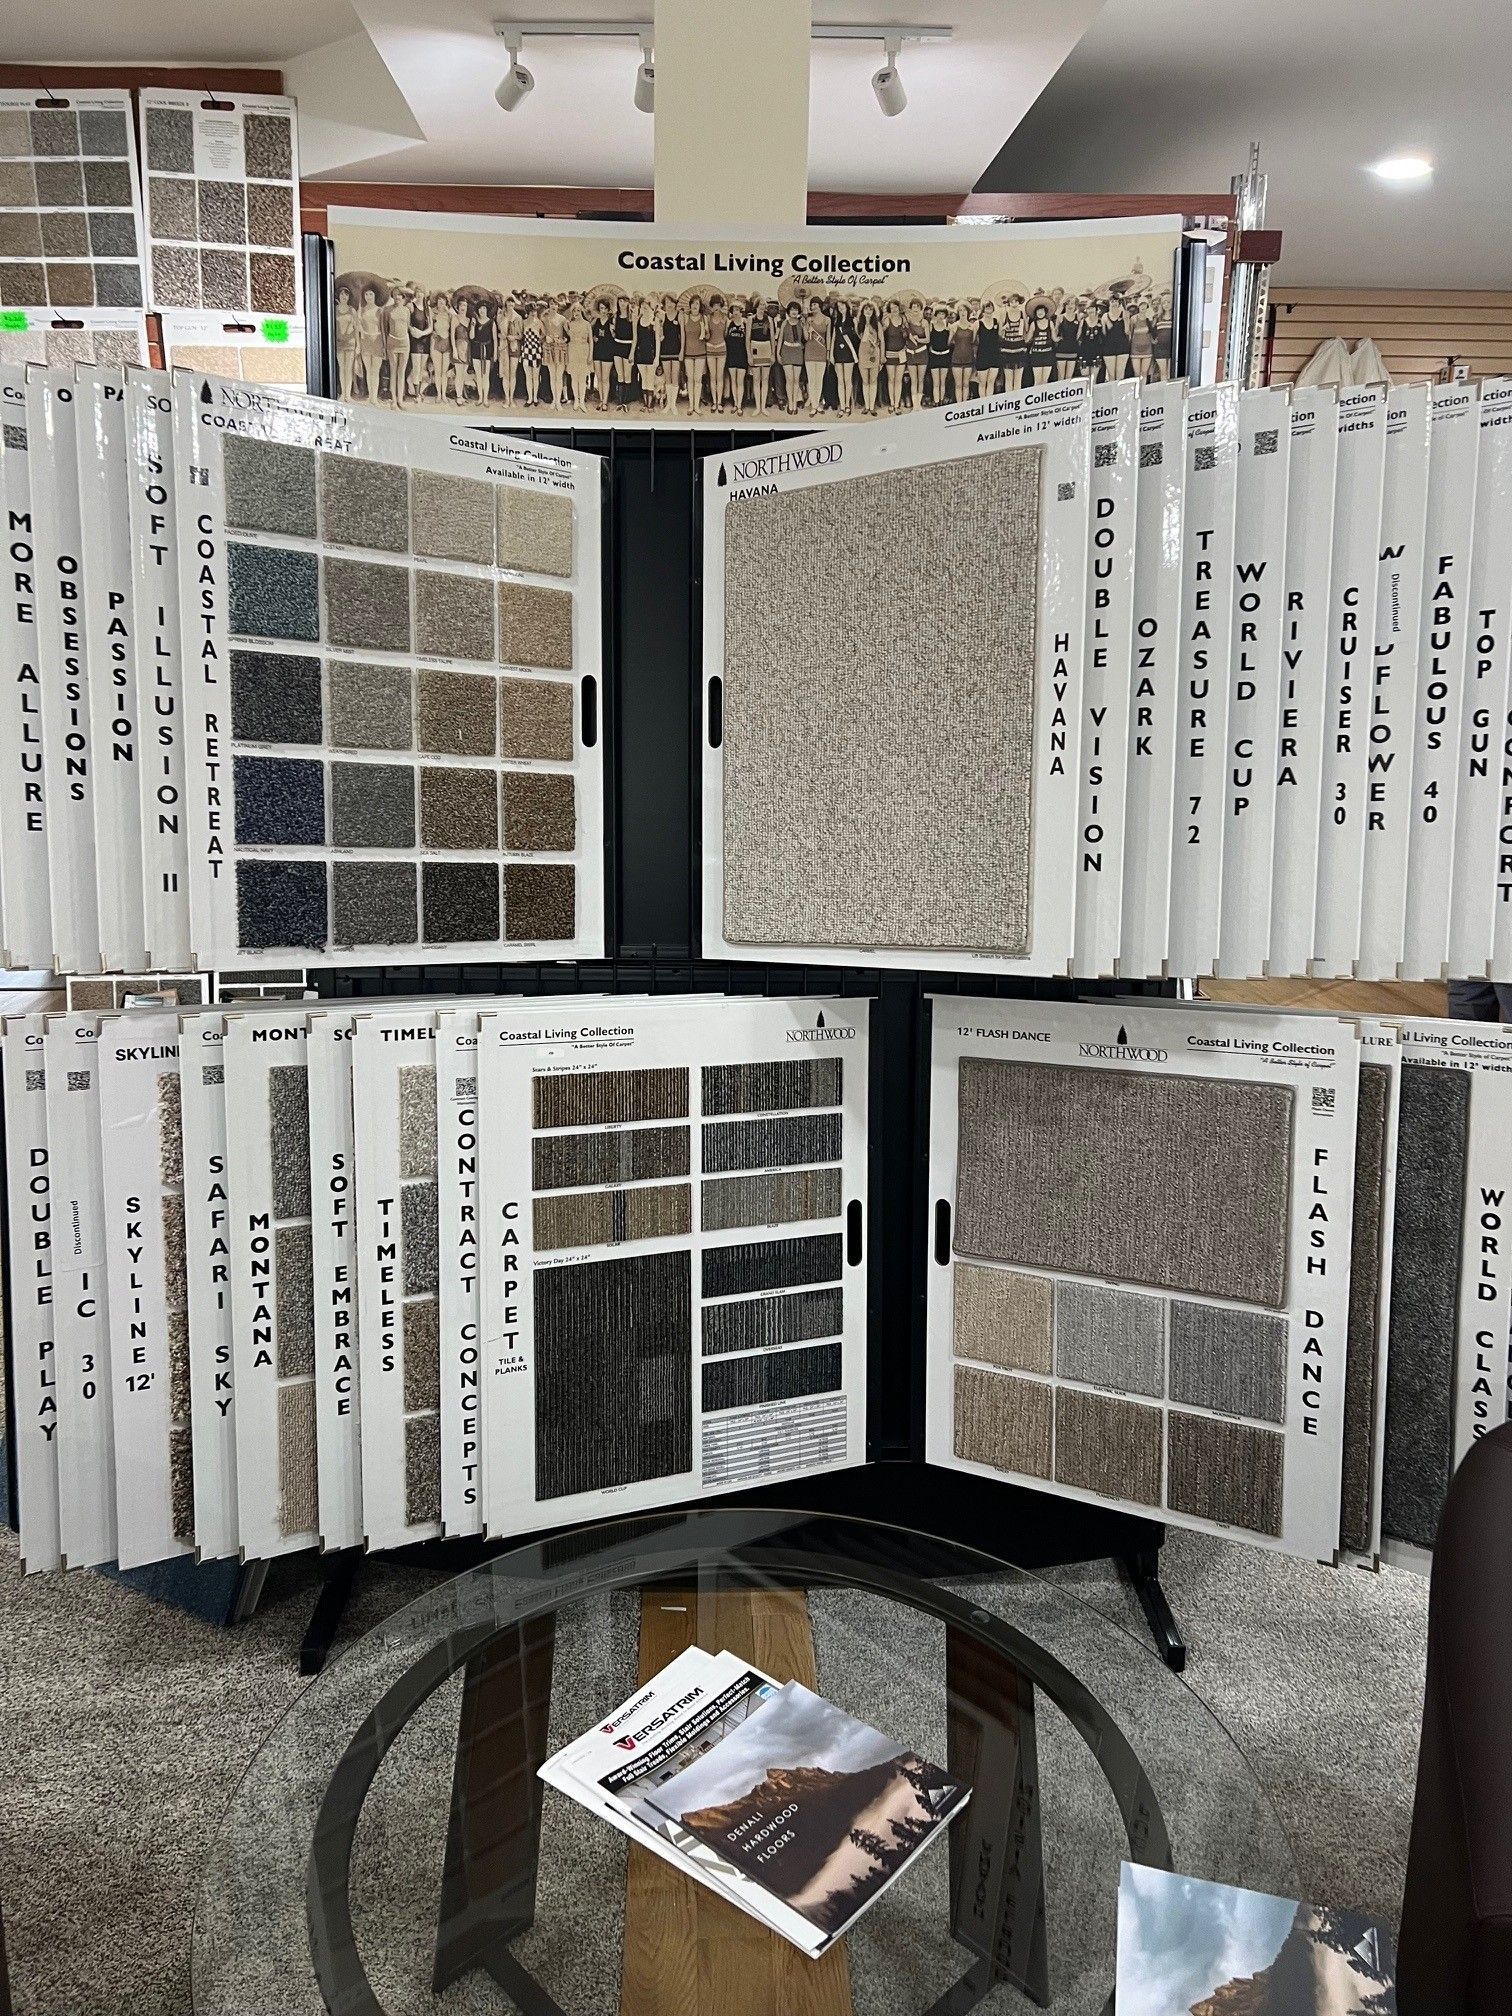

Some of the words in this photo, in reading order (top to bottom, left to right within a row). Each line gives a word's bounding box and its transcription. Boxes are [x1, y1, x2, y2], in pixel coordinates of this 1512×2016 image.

[618, 250, 706, 271] Coastal
[714, 253, 784, 278] Living
[790, 254, 911, 273] Collection
[802, 274, 824, 284] Better
[825, 274, 846, 287] Style
[847, 274, 858, 288] Of
[944, 404, 984, 422] Coastal
[988, 398, 1021, 413] Living
[1024, 386, 1084, 405] Collection
[976, 428, 1020, 443] Available
[1024, 425, 1032, 434] in
[1036, 421, 1050, 432] 12'
[1054, 416, 1082, 429] width
[450, 434, 488, 451] Coastal
[491, 442, 521, 460] Living
[486, 466, 525, 481] Available
[527, 474, 536, 482] in
[538, 476, 550, 484] 12'
[552, 480, 576, 490] width
[734, 443, 843, 481] NORTHWOOD
[145, 454, 168, 566] SOFT
[729, 484, 778, 501] HAVANA
[8, 510, 34, 624] MORE
[197, 514, 218, 684] COASTAL
[1093, 497, 1115, 668] DOUBLE
[1392, 573, 1401, 632] Discontinued
[1190, 529, 1214, 758] TREASURE
[1236, 561, 1267, 700] WORLD
[1426, 555, 1455, 750] FABULOUS
[1476, 608, 1496, 679] TOP
[56, 555, 87, 801] OBSESSIONS
[107, 591, 133, 762] PASSION
[1050, 632, 1070, 776] HAVANA
[1136, 617, 1158, 756] OZARK
[1277, 591, 1304, 786] RIVIERA
[1336, 587, 1360, 753] CRUISER
[16, 663, 44, 832] ALLURE
[154, 606, 179, 834] ILLUSION
[1469, 708, 1490, 777] GUN
[205, 713, 224, 879] RETREAT
[1084, 706, 1108, 872] VISION
[1233, 739, 1253, 816] CUP
[1334, 782, 1346, 825] 30
[1422, 781, 1438, 823] 40
[1188, 796, 1202, 844] 72
[162, 873, 178, 892] II
[115, 1045, 180, 1062] SKYLIN
[500, 1030, 542, 1041] Coastal
[544, 1028, 577, 1040] Living
[580, 1026, 634, 1038] Collection
[786, 1028, 856, 1042] NORTHWOOD
[956, 1026, 974, 1037] 12'
[976, 1028, 1009, 1040] FLASH
[1012, 1030, 1052, 1042] DANCE
[1078, 1044, 1168, 1062] NORTHWOOD
[1187, 1036, 1230, 1048] Coastal
[1234, 1038, 1269, 1053] Living
[1272, 1042, 1335, 1056] Collection
[1402, 1055, 1446, 1067] Available
[1450, 1060, 1460, 1068] in
[1414, 1032, 1448, 1046] Living
[1452, 1034, 1512, 1050] Collection
[30, 1148, 53, 1306] DOUBLE
[70, 1200, 82, 1255] Discontinued
[207, 1156, 229, 1310] SAFARI
[330, 1154, 348, 1238] SOFT
[457, 1109, 477, 1293] CONTRACT
[1307, 1148, 1328, 1276] FLASH
[126, 1196, 146, 1364] SKYLINE
[502, 1202, 520, 1350] CARPET
[533, 1259, 552, 1267] Victory
[1478, 1187, 1506, 1302] WORLD
[249, 1212, 273, 1369] MONTANA
[377, 1198, 396, 1372] TIMELESS
[82, 1354, 96, 1400] 30
[332, 1265, 352, 1416] EMBRACE
[495, 1364, 528, 1375] PLANKS
[499, 1356, 516, 1366] TILE
[1302, 1309, 1324, 1436] DANCE
[38, 1340, 58, 1442] PLAY
[125, 1373, 155, 1392] 12'
[214, 1345, 233, 1417] SKY
[460, 1323, 478, 1505] CONCEPTS
[1472, 1330, 1495, 1440] CLASS
[600, 1690, 656, 1734] VERSATRIM
[608, 1755, 650, 1784] Award-Winning
[648, 1746, 664, 1762] Floor
[662, 1732, 682, 1750] Trims,
[678, 1720, 694, 1737] Stair
[692, 1702, 718, 1726] Solutions,
[716, 1676, 750, 1708] Perfect-Match
[612, 1686, 704, 1751] VERSATRIM
[622, 1772, 635, 1784] Full
[634, 1764, 648, 1780] Stair
[648, 1752, 669, 1769] Treads,
[666, 1738, 688, 1758] Flexible
[686, 1718, 710, 1741] Moldings
[708, 1710, 722, 1722] and
[719, 1687, 750, 1713] Accessories.
[726, 1811, 764, 1842] DENALI
[741, 1802, 799, 1852] HARDWOOD
[757, 1829, 796, 1864] FLOORS
